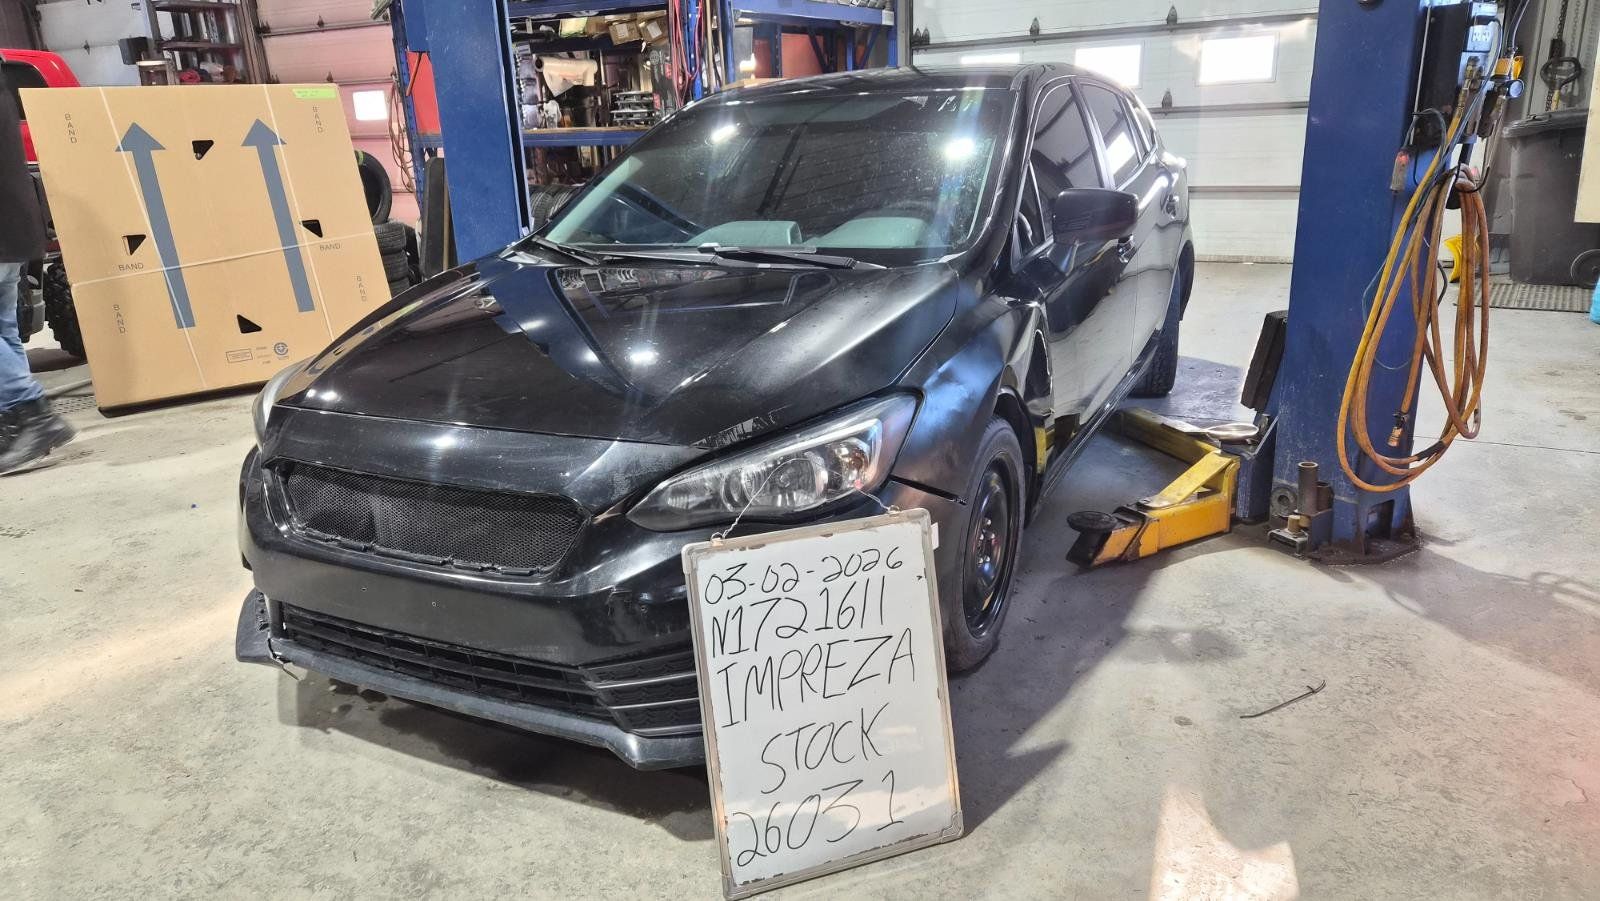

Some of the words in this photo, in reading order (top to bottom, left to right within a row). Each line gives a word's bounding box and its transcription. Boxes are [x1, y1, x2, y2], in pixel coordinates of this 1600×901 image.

[64, 113, 77, 144] BAND
[312, 105, 324, 133] BAND
[319, 242, 341, 251] BAND
[118, 262, 144, 271] BAND
[356, 275, 367, 302] BAND
[113, 304, 126, 334] BAND
[704, 547, 903, 605] 03-02-2026
[712, 576, 886, 658] N1721611
[717, 627, 915, 728] IMPREZA
[760, 702, 890, 795] STOCK
